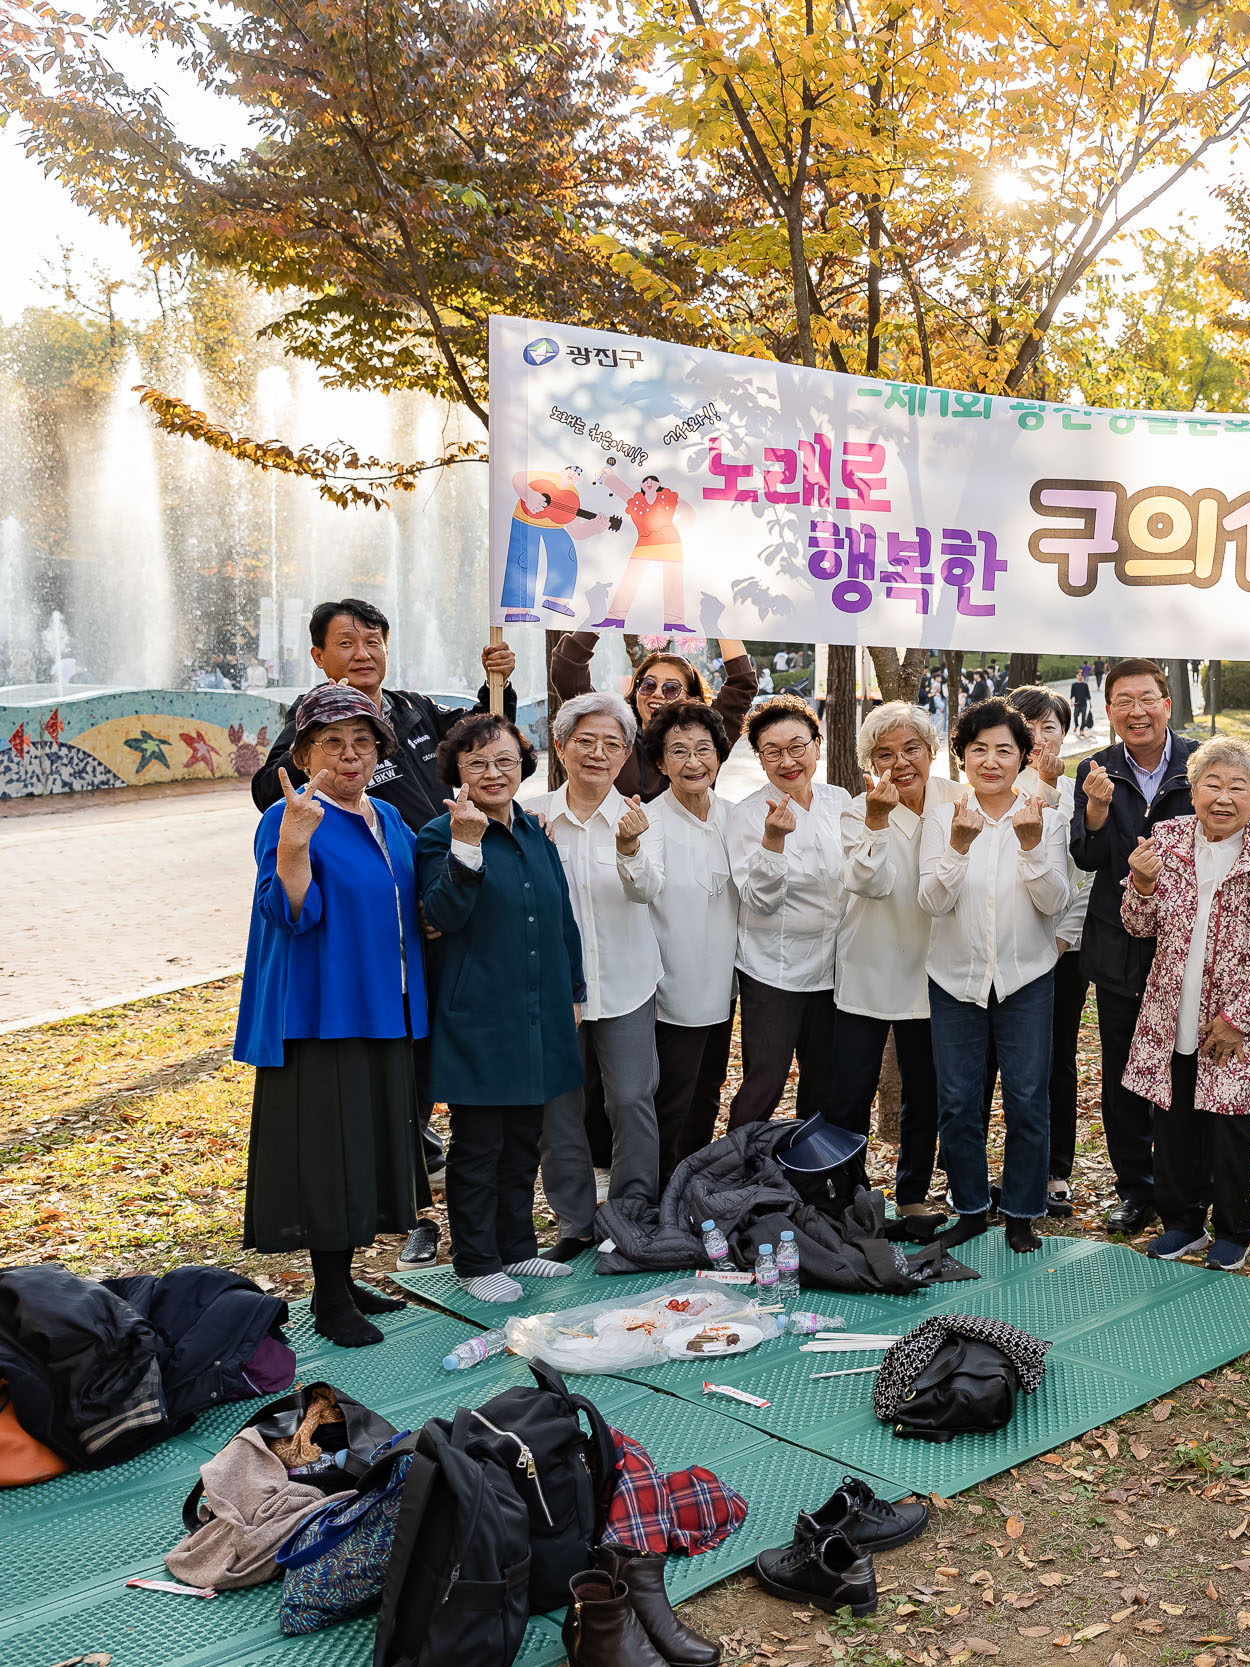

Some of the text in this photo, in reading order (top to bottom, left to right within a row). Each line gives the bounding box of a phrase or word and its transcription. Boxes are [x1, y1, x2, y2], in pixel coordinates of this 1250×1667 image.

[566, 345, 645, 369] 광진구
[550, 406, 587, 435] 노래는
[702, 432, 891, 512] 노래로
[808, 520, 1008, 616] 행복한
[373, 769, 396, 783] BKW
